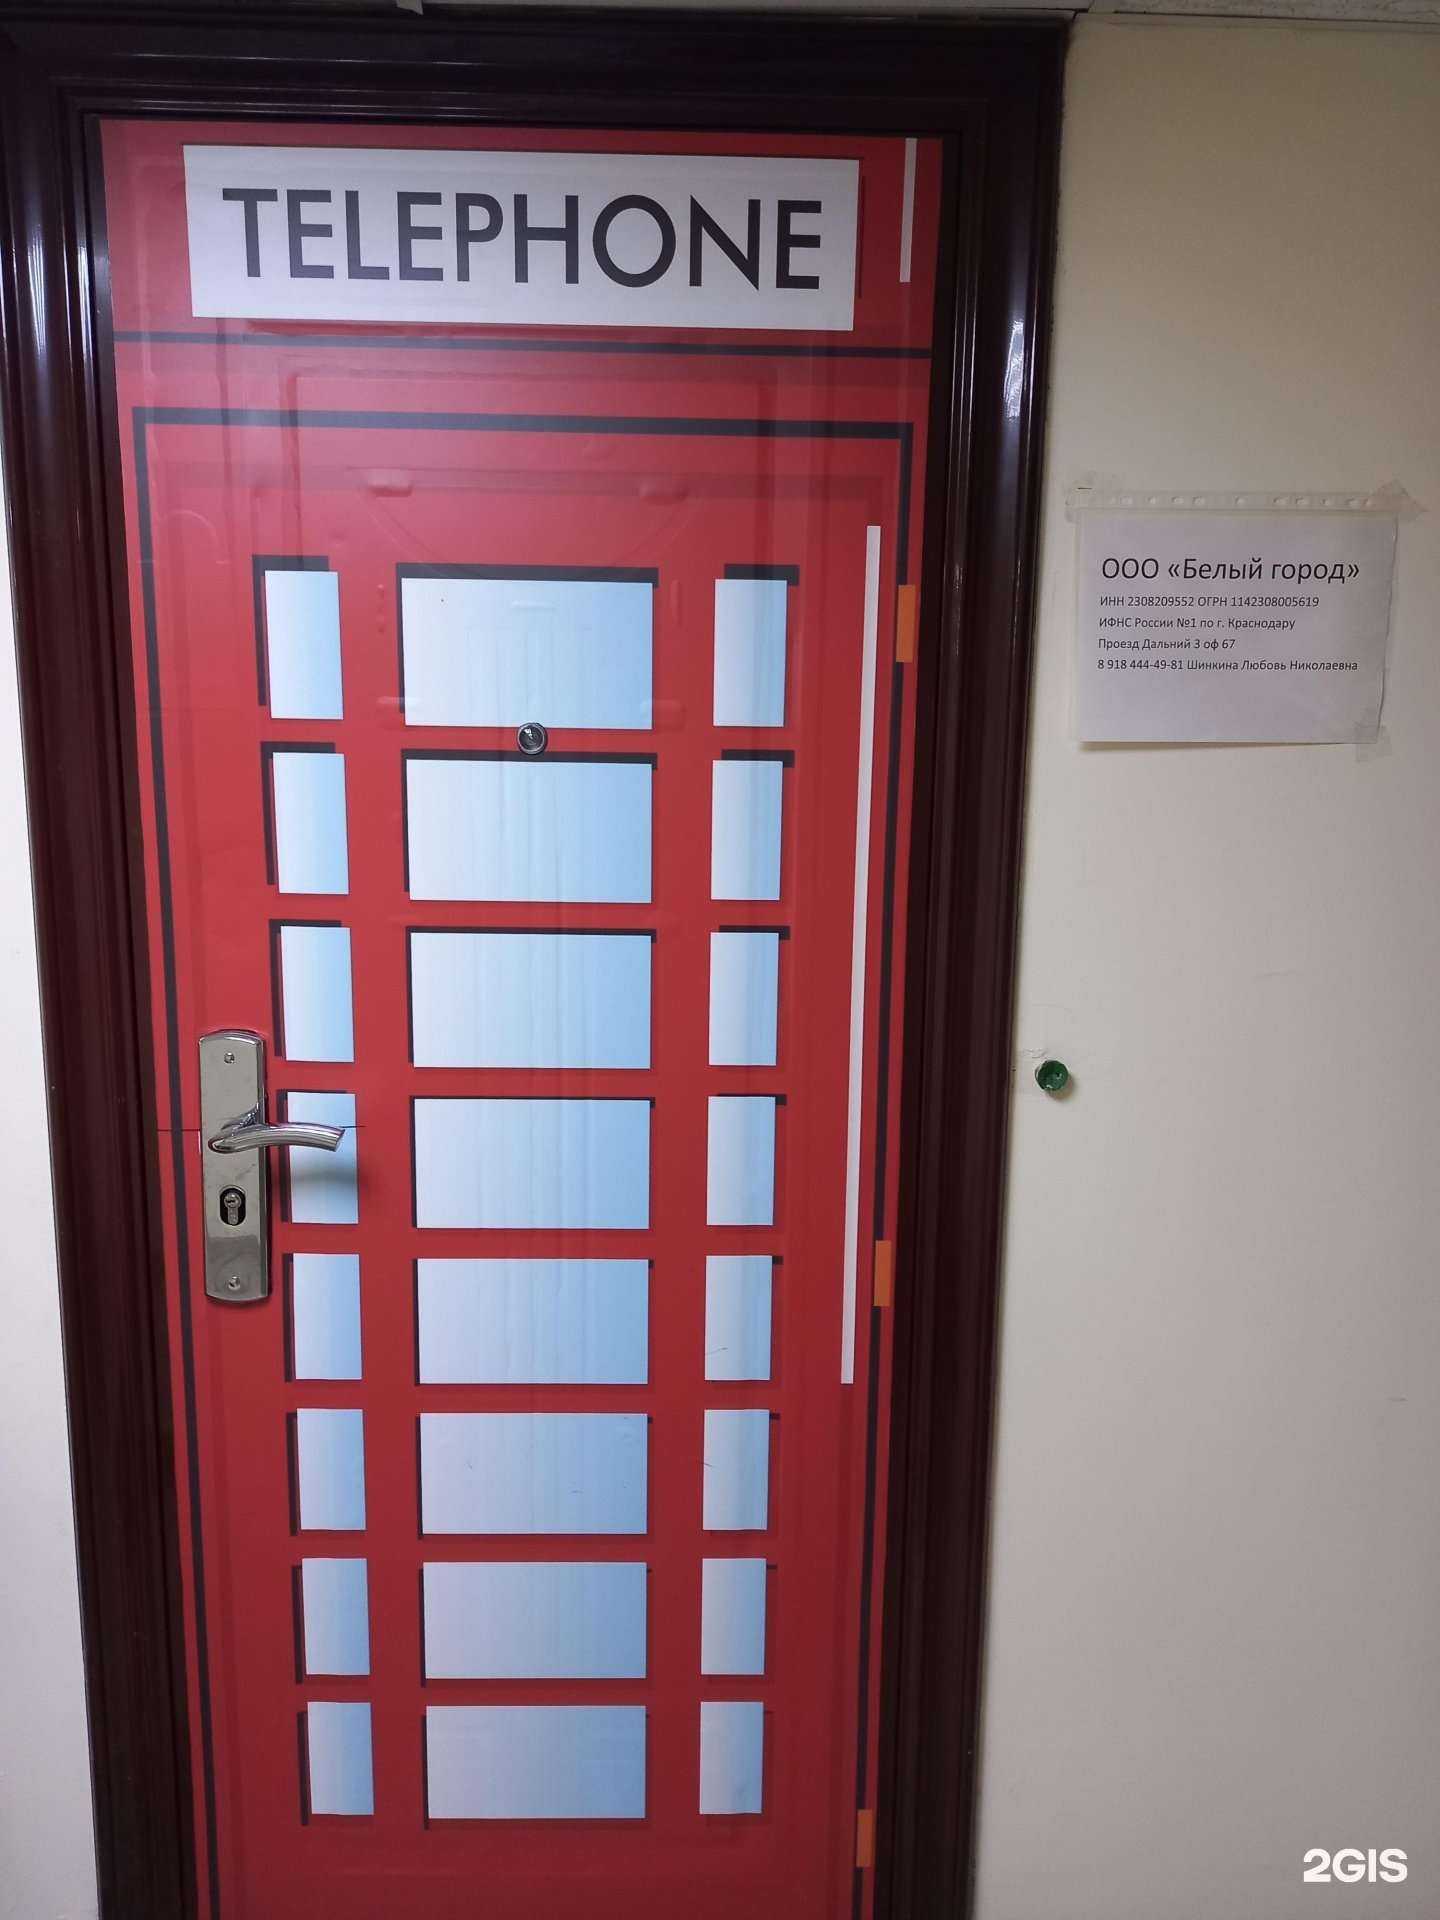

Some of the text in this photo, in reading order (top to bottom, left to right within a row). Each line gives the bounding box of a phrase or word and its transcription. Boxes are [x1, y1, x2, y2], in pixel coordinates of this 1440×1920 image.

[222, 188, 822, 290] TELEPHONE
[1102, 557, 1359, 584] ООО «Белый город»
[1100, 596, 1320, 607] ИНН 2308209552 ОГРН 1142308005619
[1099, 617, 1296, 631] ИФНС России №1 по г. Краснодару
[1098, 638, 1236, 651] Проезд Дальний 3 оф 67
[1097, 659, 1358, 671] 8 918 444-49-81 Шинкина Любовь Николаевна
